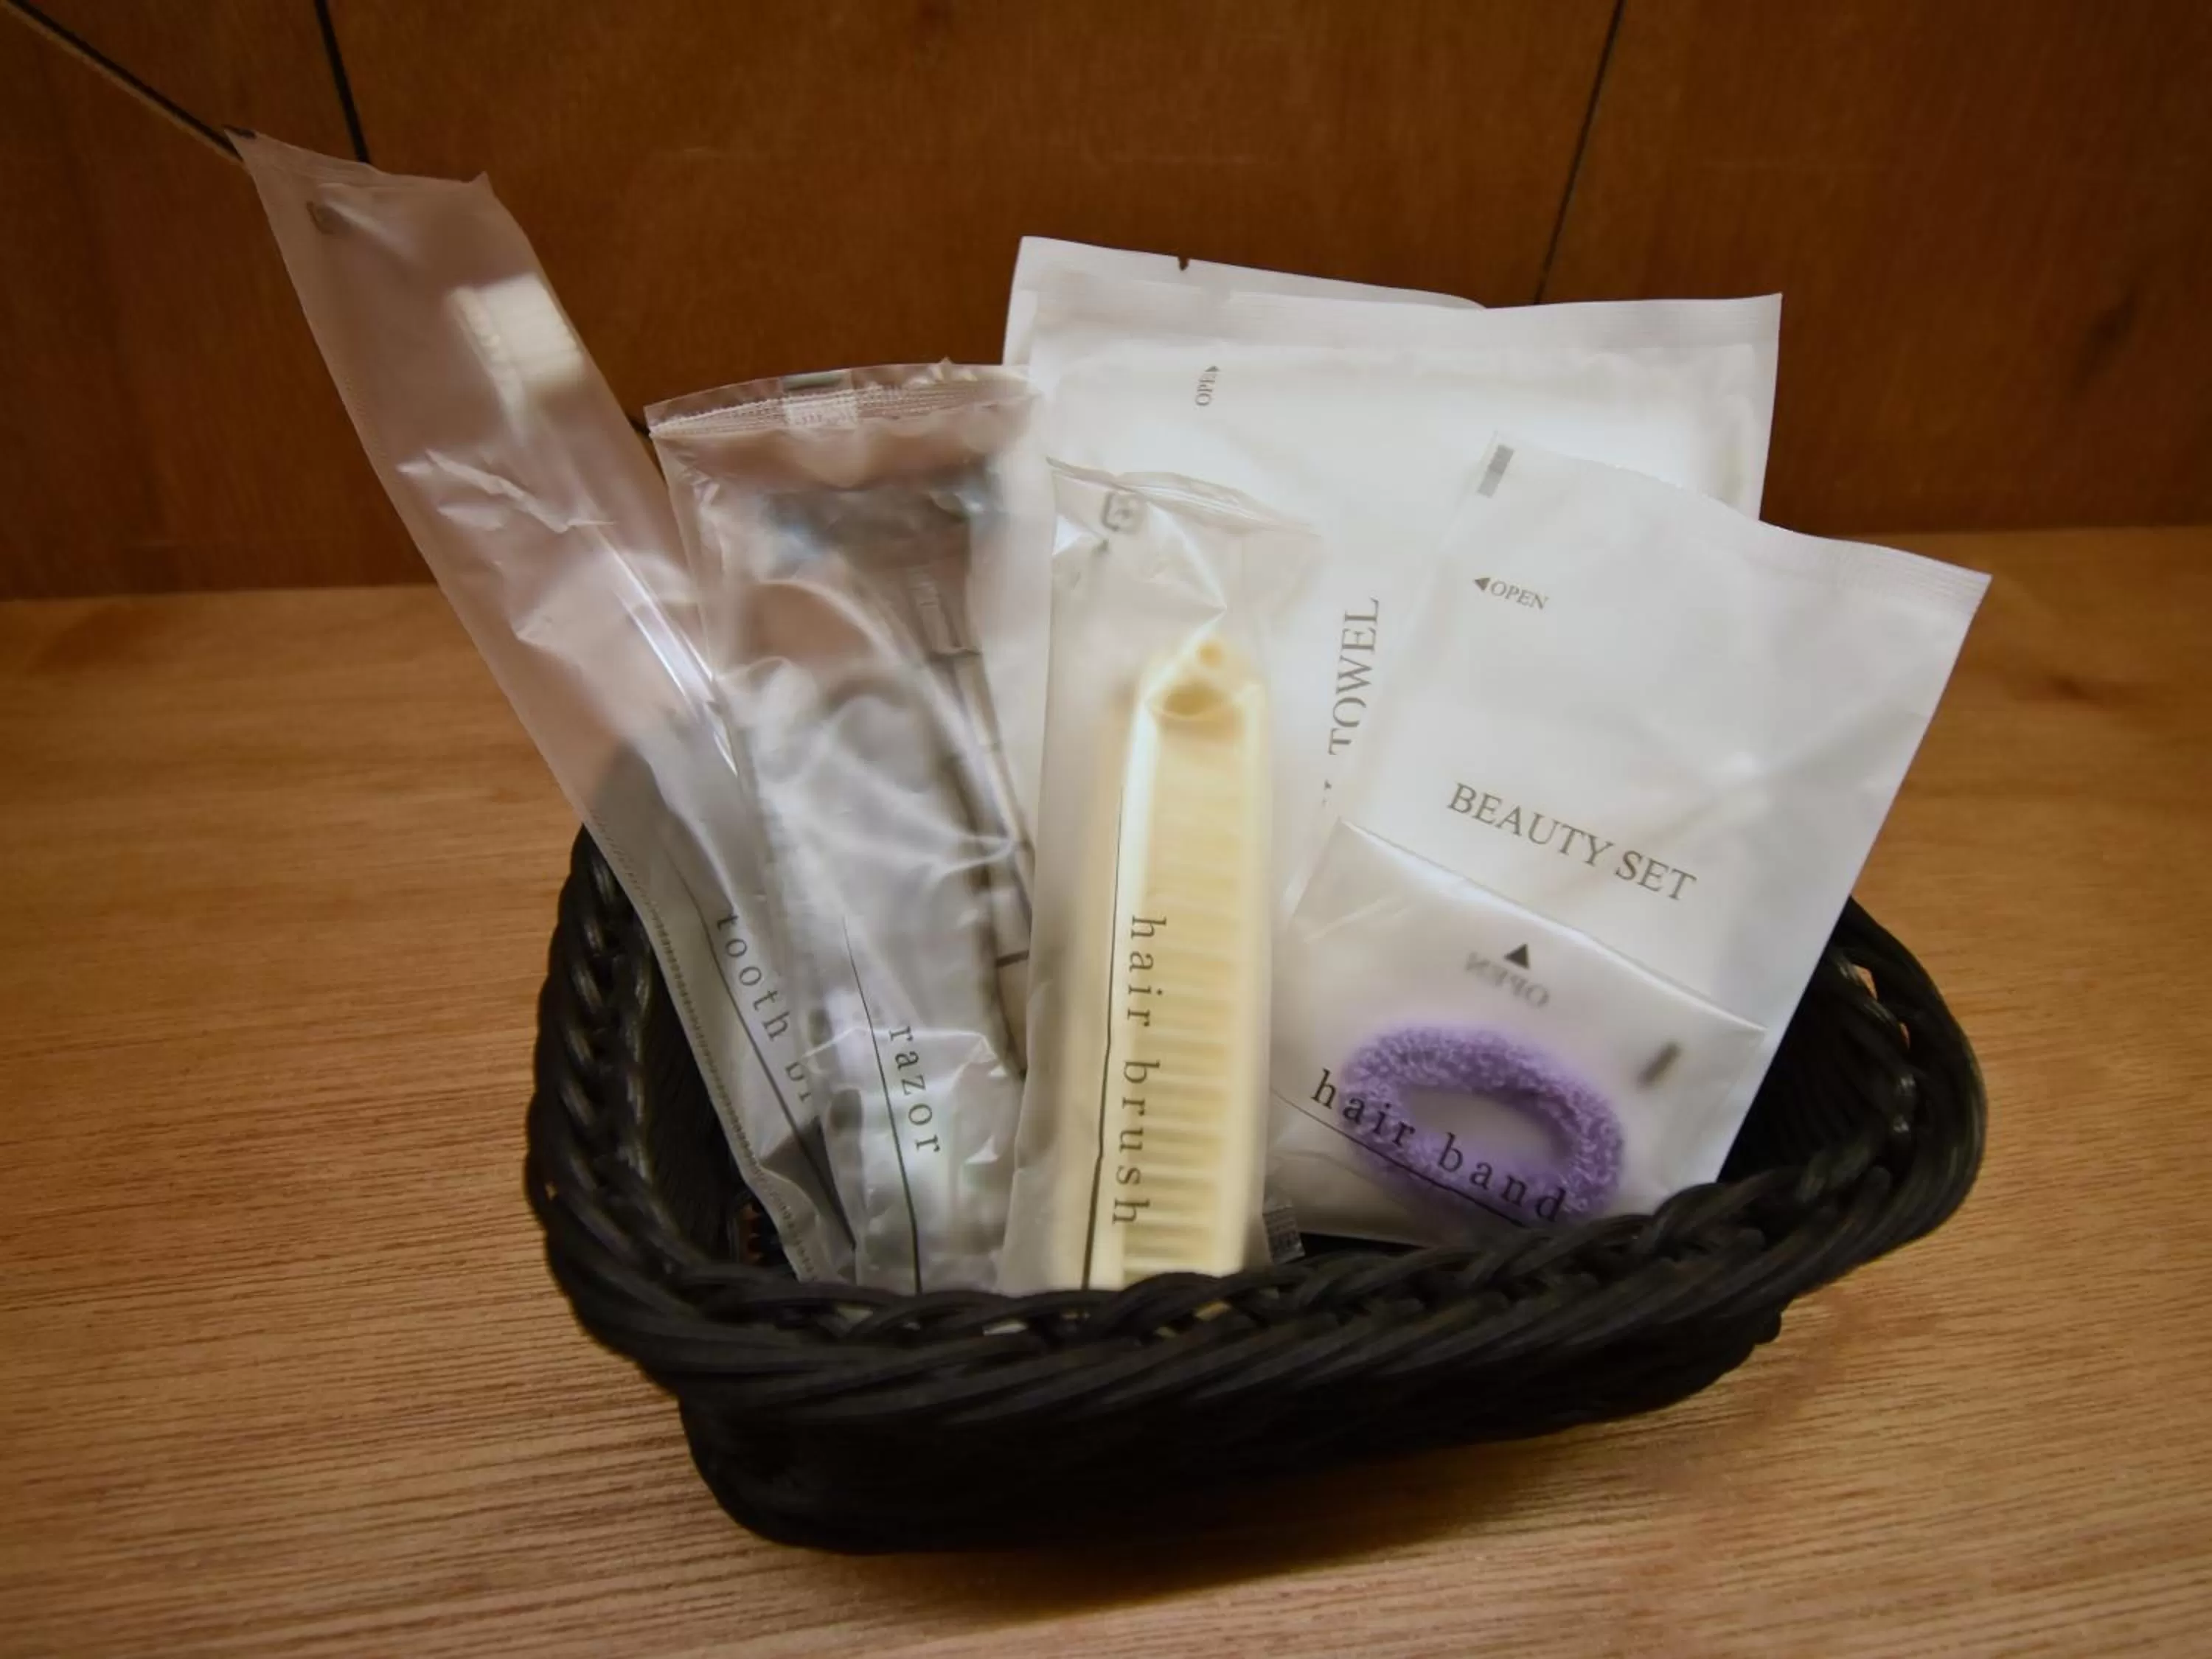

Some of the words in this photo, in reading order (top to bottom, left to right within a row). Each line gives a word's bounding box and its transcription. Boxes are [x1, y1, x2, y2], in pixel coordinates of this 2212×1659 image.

[1490, 580, 1550, 611] OPEN
[1328, 596, 1380, 756] TOWEL
[1447, 782, 1613, 868] BEAUTY
[1615, 849, 1697, 901] SET
[717, 914, 790, 1041] tooth
[1127, 914, 1166, 1027] hair
[889, 1025, 940, 1154] razor
[1111, 1059, 1160, 1225] brush
[1310, 1068, 1416, 1147] hair
[1436, 1133, 1568, 1223] band
